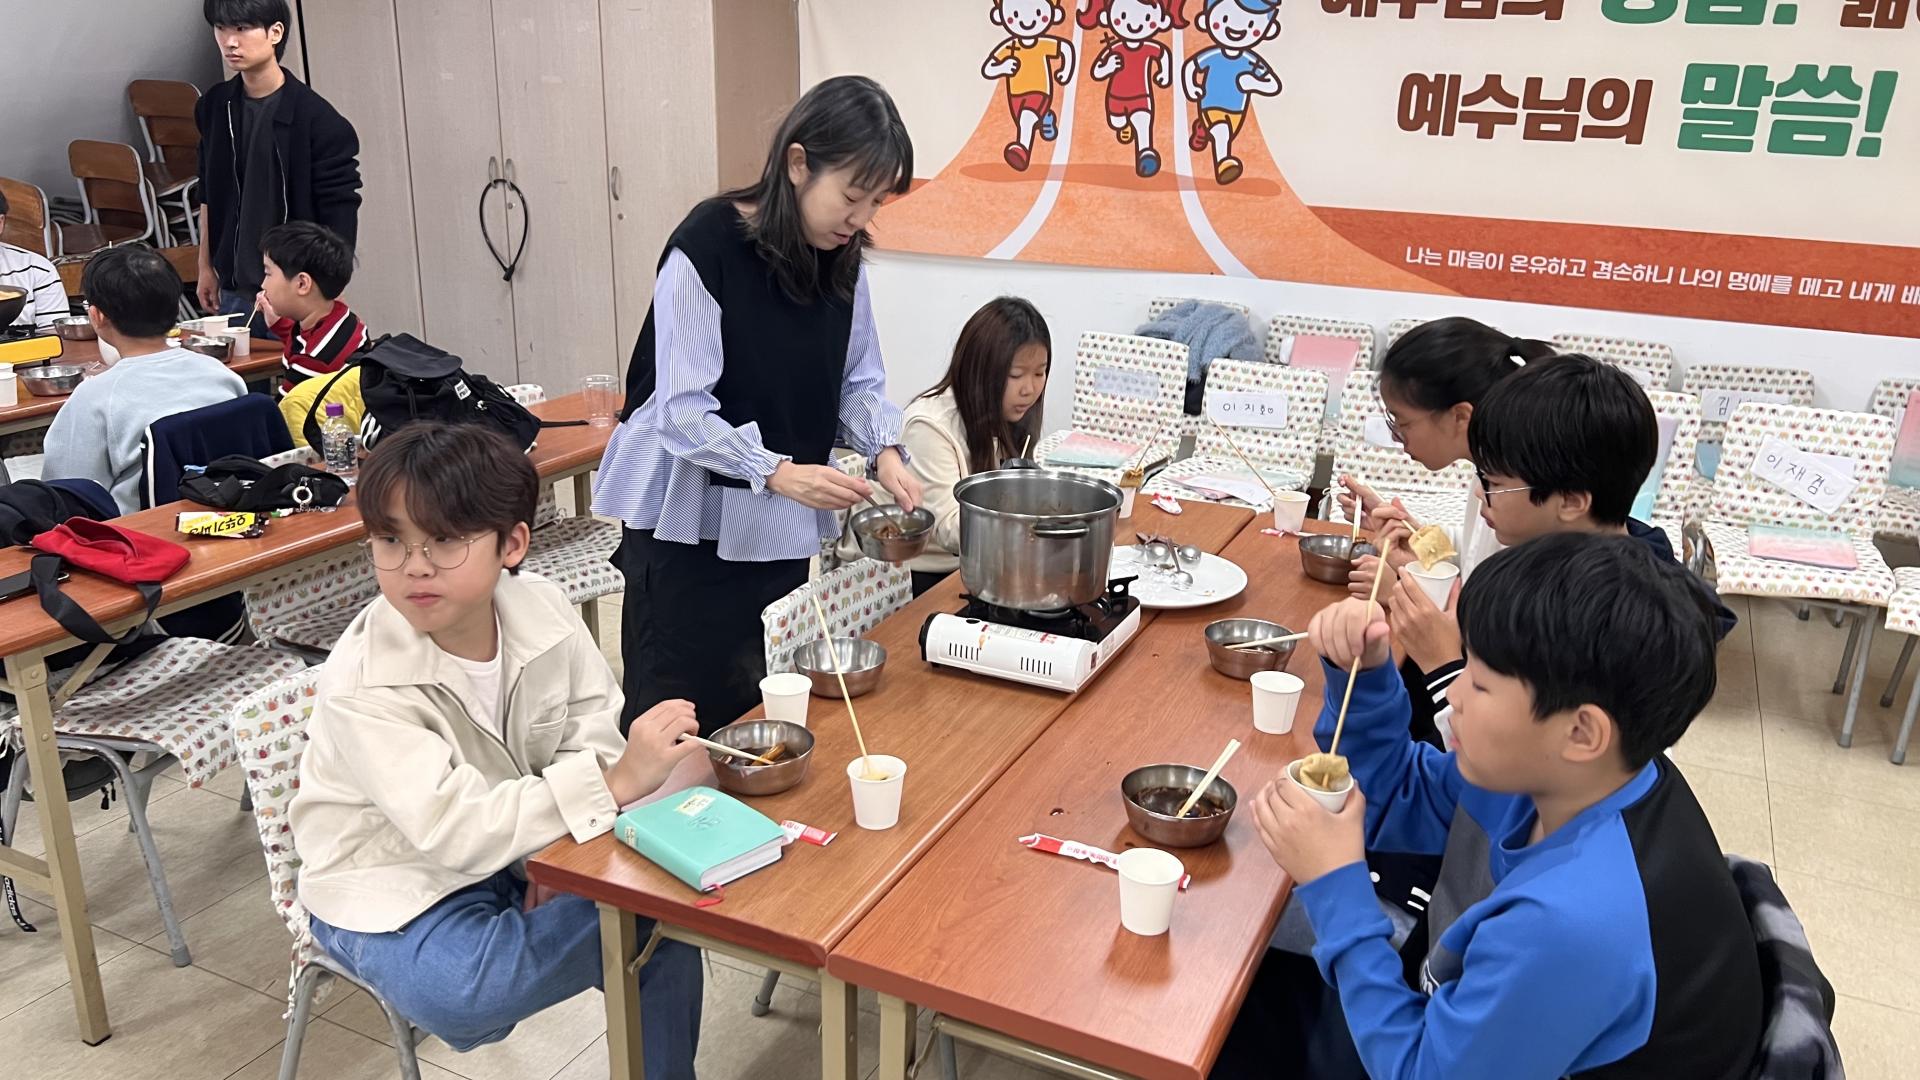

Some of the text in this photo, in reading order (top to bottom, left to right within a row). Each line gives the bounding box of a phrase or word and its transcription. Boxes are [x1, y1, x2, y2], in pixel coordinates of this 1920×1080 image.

[1397, 62, 1899, 158] 예수님의 말씀!
[1406, 246, 1442, 266] 나는
[1447, 249, 1504, 270] 마음이
[1510, 254, 1587, 277] 온유하고
[1592, 260, 1674, 284] 겸손하니
[1679, 267, 1722, 288] 나의
[1727, 271, 1793, 295] 멍에를
[1798, 277, 1843, 298] 메고
[1849, 281, 1896, 302] 내게
